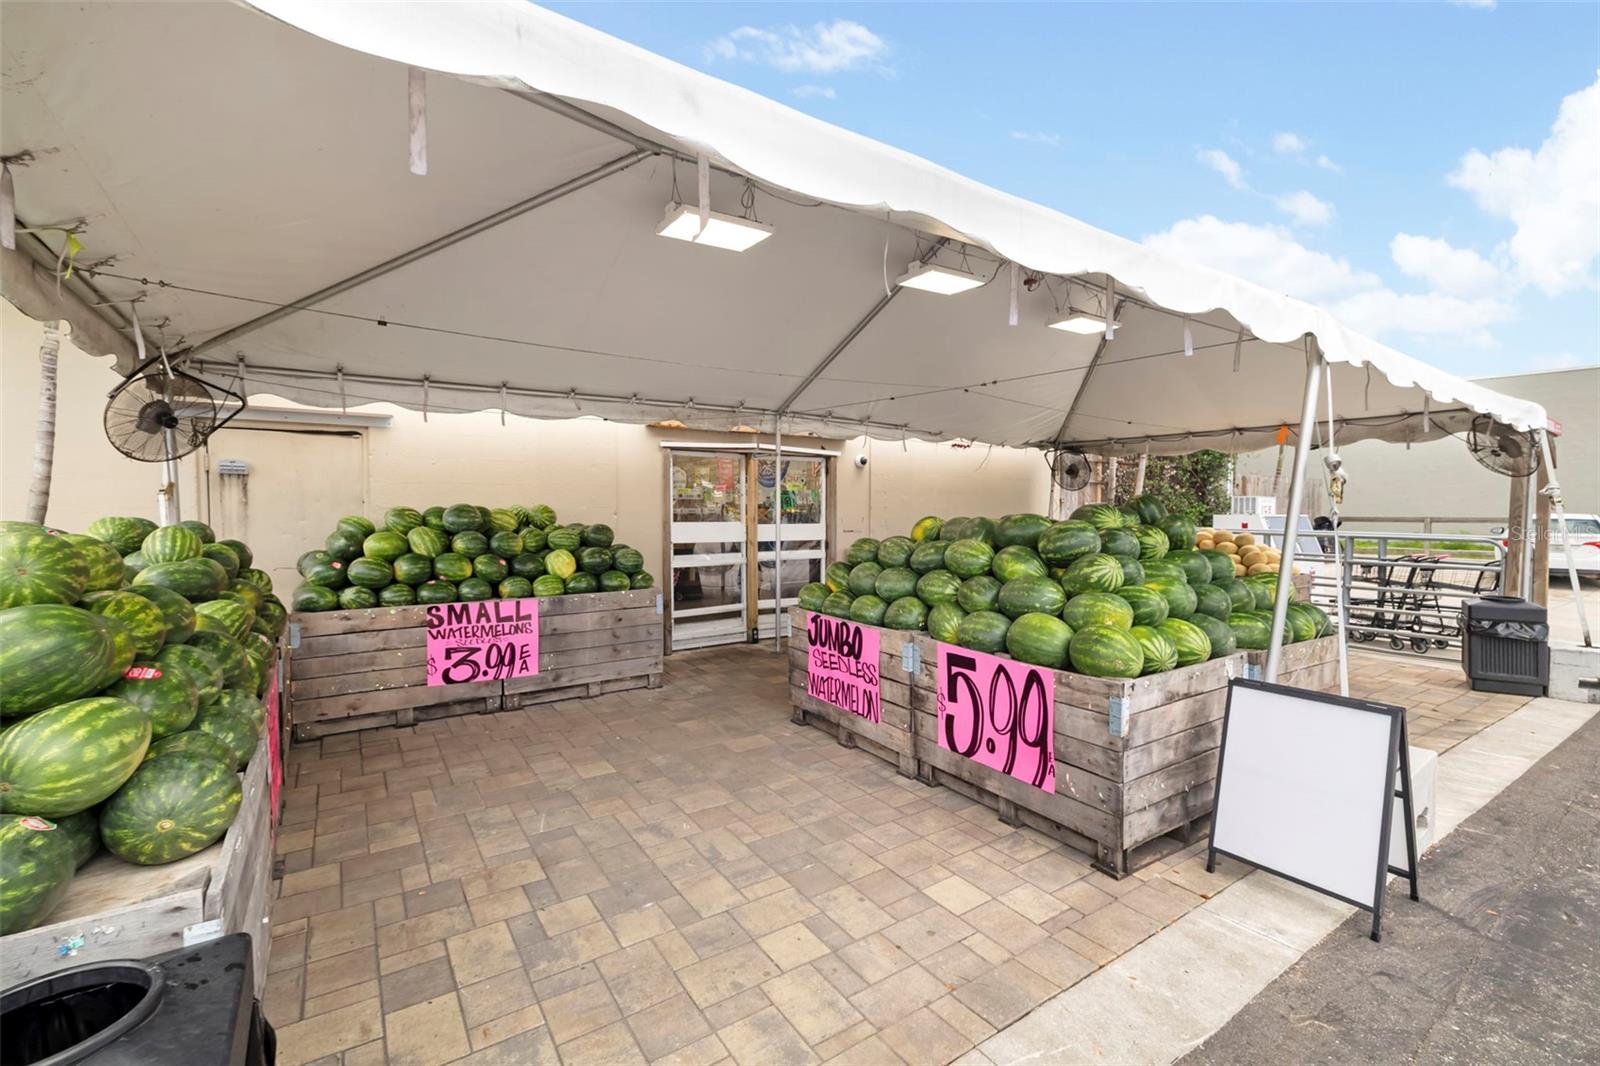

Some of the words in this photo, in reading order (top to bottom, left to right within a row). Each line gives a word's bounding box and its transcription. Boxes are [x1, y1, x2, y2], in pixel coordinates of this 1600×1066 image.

[427, 601, 532, 629] SMALL
[428, 622, 533, 640] WATERMELONS
[808, 614, 863, 660] JUMBO
[813, 648, 878, 686] SEEDLESS
[808, 672, 879, 724] WATERMELON
